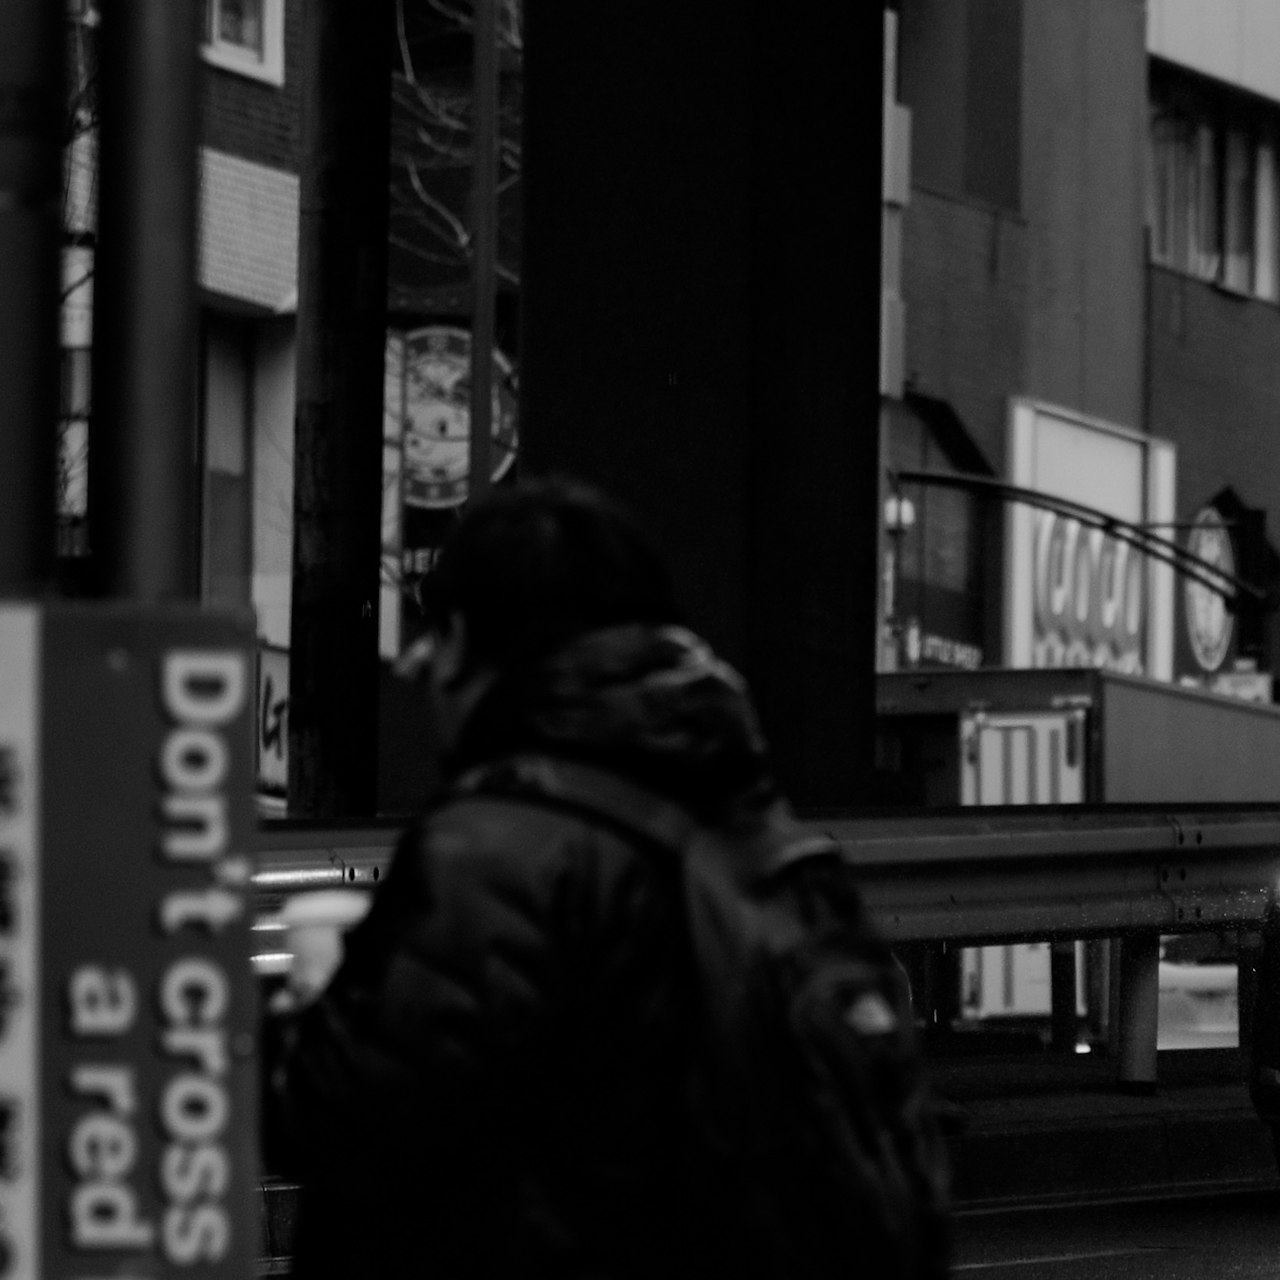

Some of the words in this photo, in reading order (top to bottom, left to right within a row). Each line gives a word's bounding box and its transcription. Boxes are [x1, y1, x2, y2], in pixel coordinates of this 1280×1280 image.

[161, 648, 249, 935] Don't
[70, 965, 138, 1034] a
[160, 956, 229, 1263] cross
[70, 1065, 155, 1248] red
